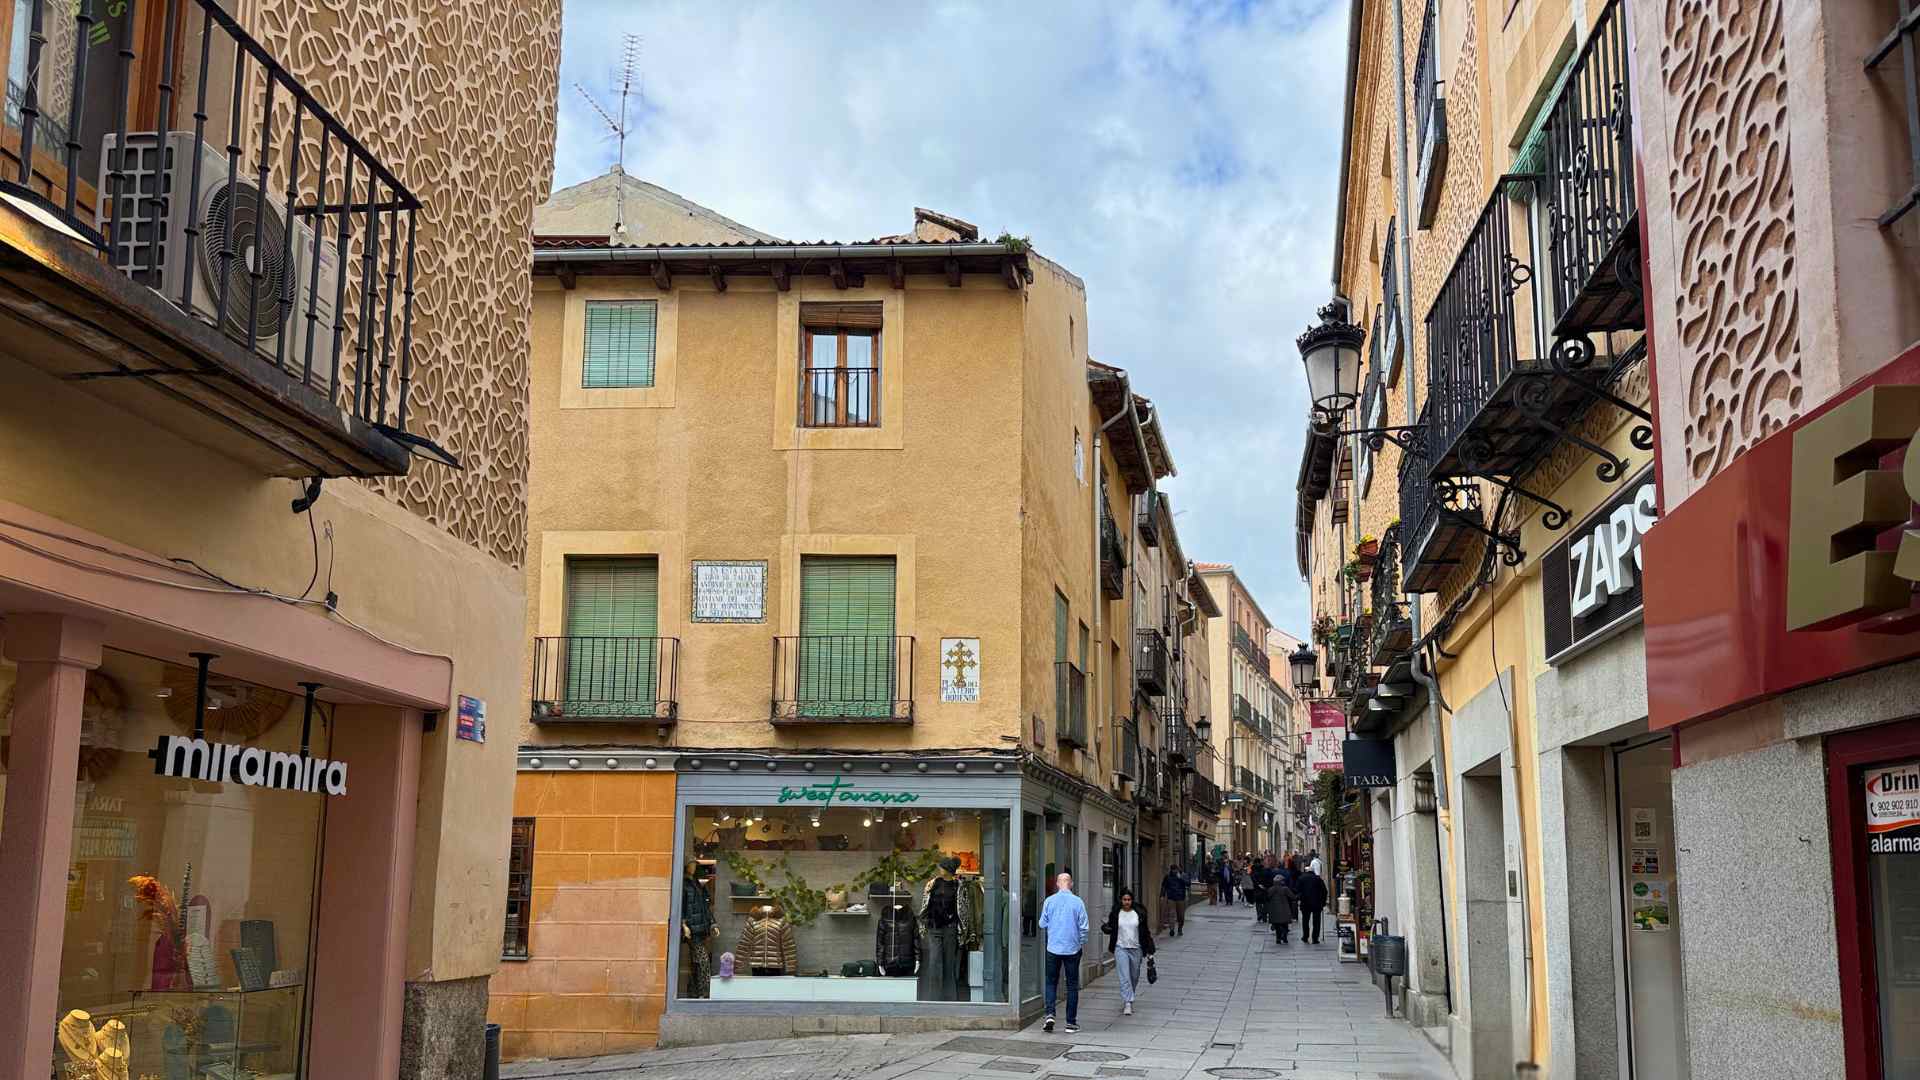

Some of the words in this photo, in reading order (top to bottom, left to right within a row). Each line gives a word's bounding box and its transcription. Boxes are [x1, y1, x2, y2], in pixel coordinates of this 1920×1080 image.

[1787, 384, 1920, 633] E
[164, 735, 348, 796] miramira
[1352, 775, 1391, 785] TARA
[1878, 801, 1890, 811] 902
[1891, 800, 1904, 810] 902
[1905, 799, 1919, 809] 910
